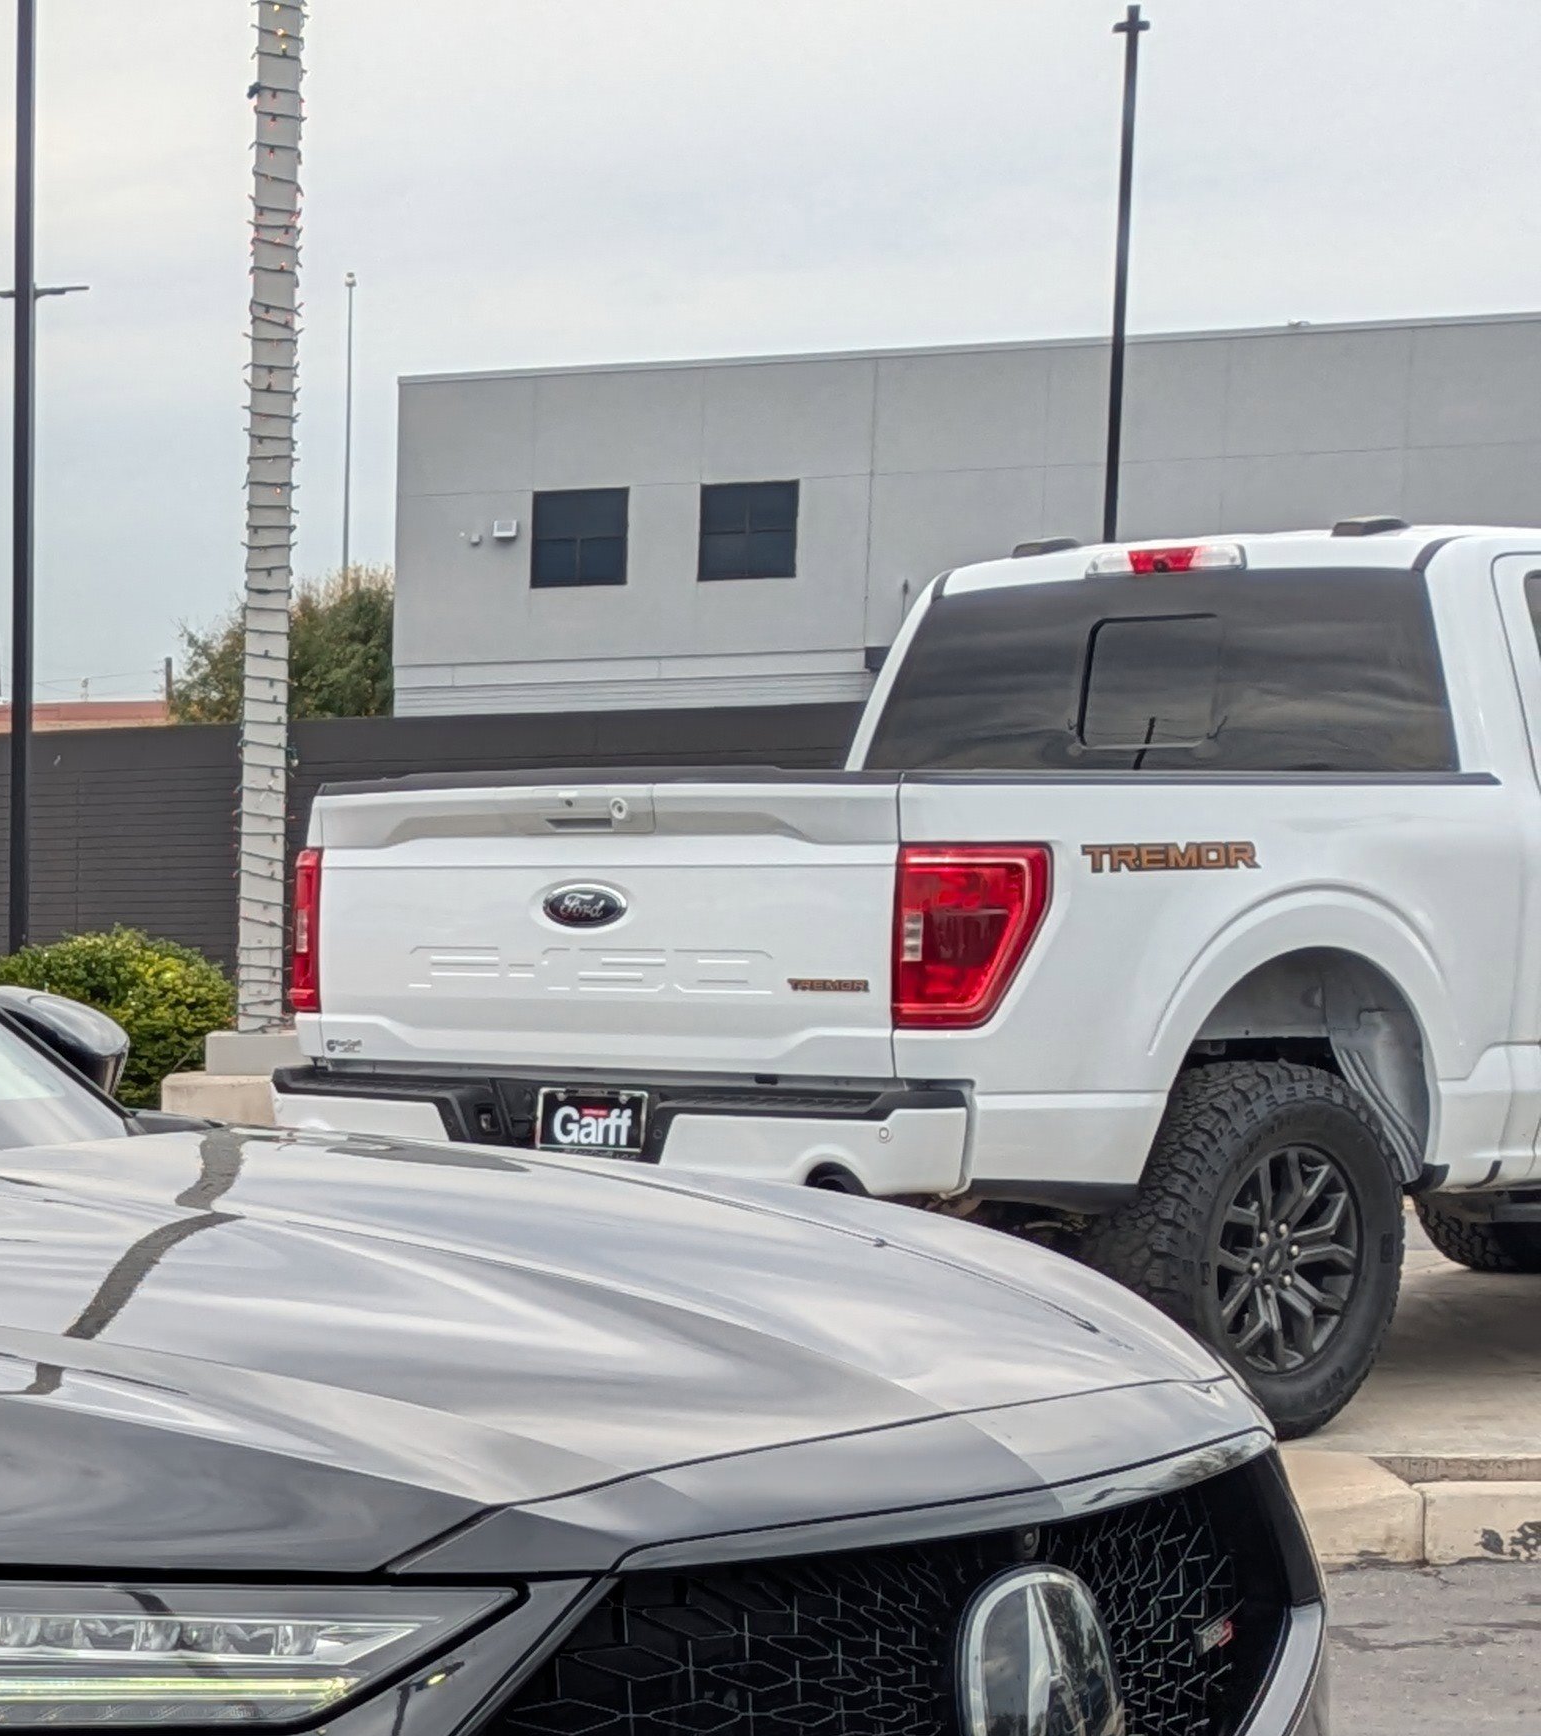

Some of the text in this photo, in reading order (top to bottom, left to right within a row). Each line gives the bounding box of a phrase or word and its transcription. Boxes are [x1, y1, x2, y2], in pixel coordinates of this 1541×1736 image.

[1080, 841, 1262, 873] TREMOR
[559, 892, 606, 918] Ford
[786, 977, 871, 993] TREMOR
[553, 1105, 633, 1147] Garff
